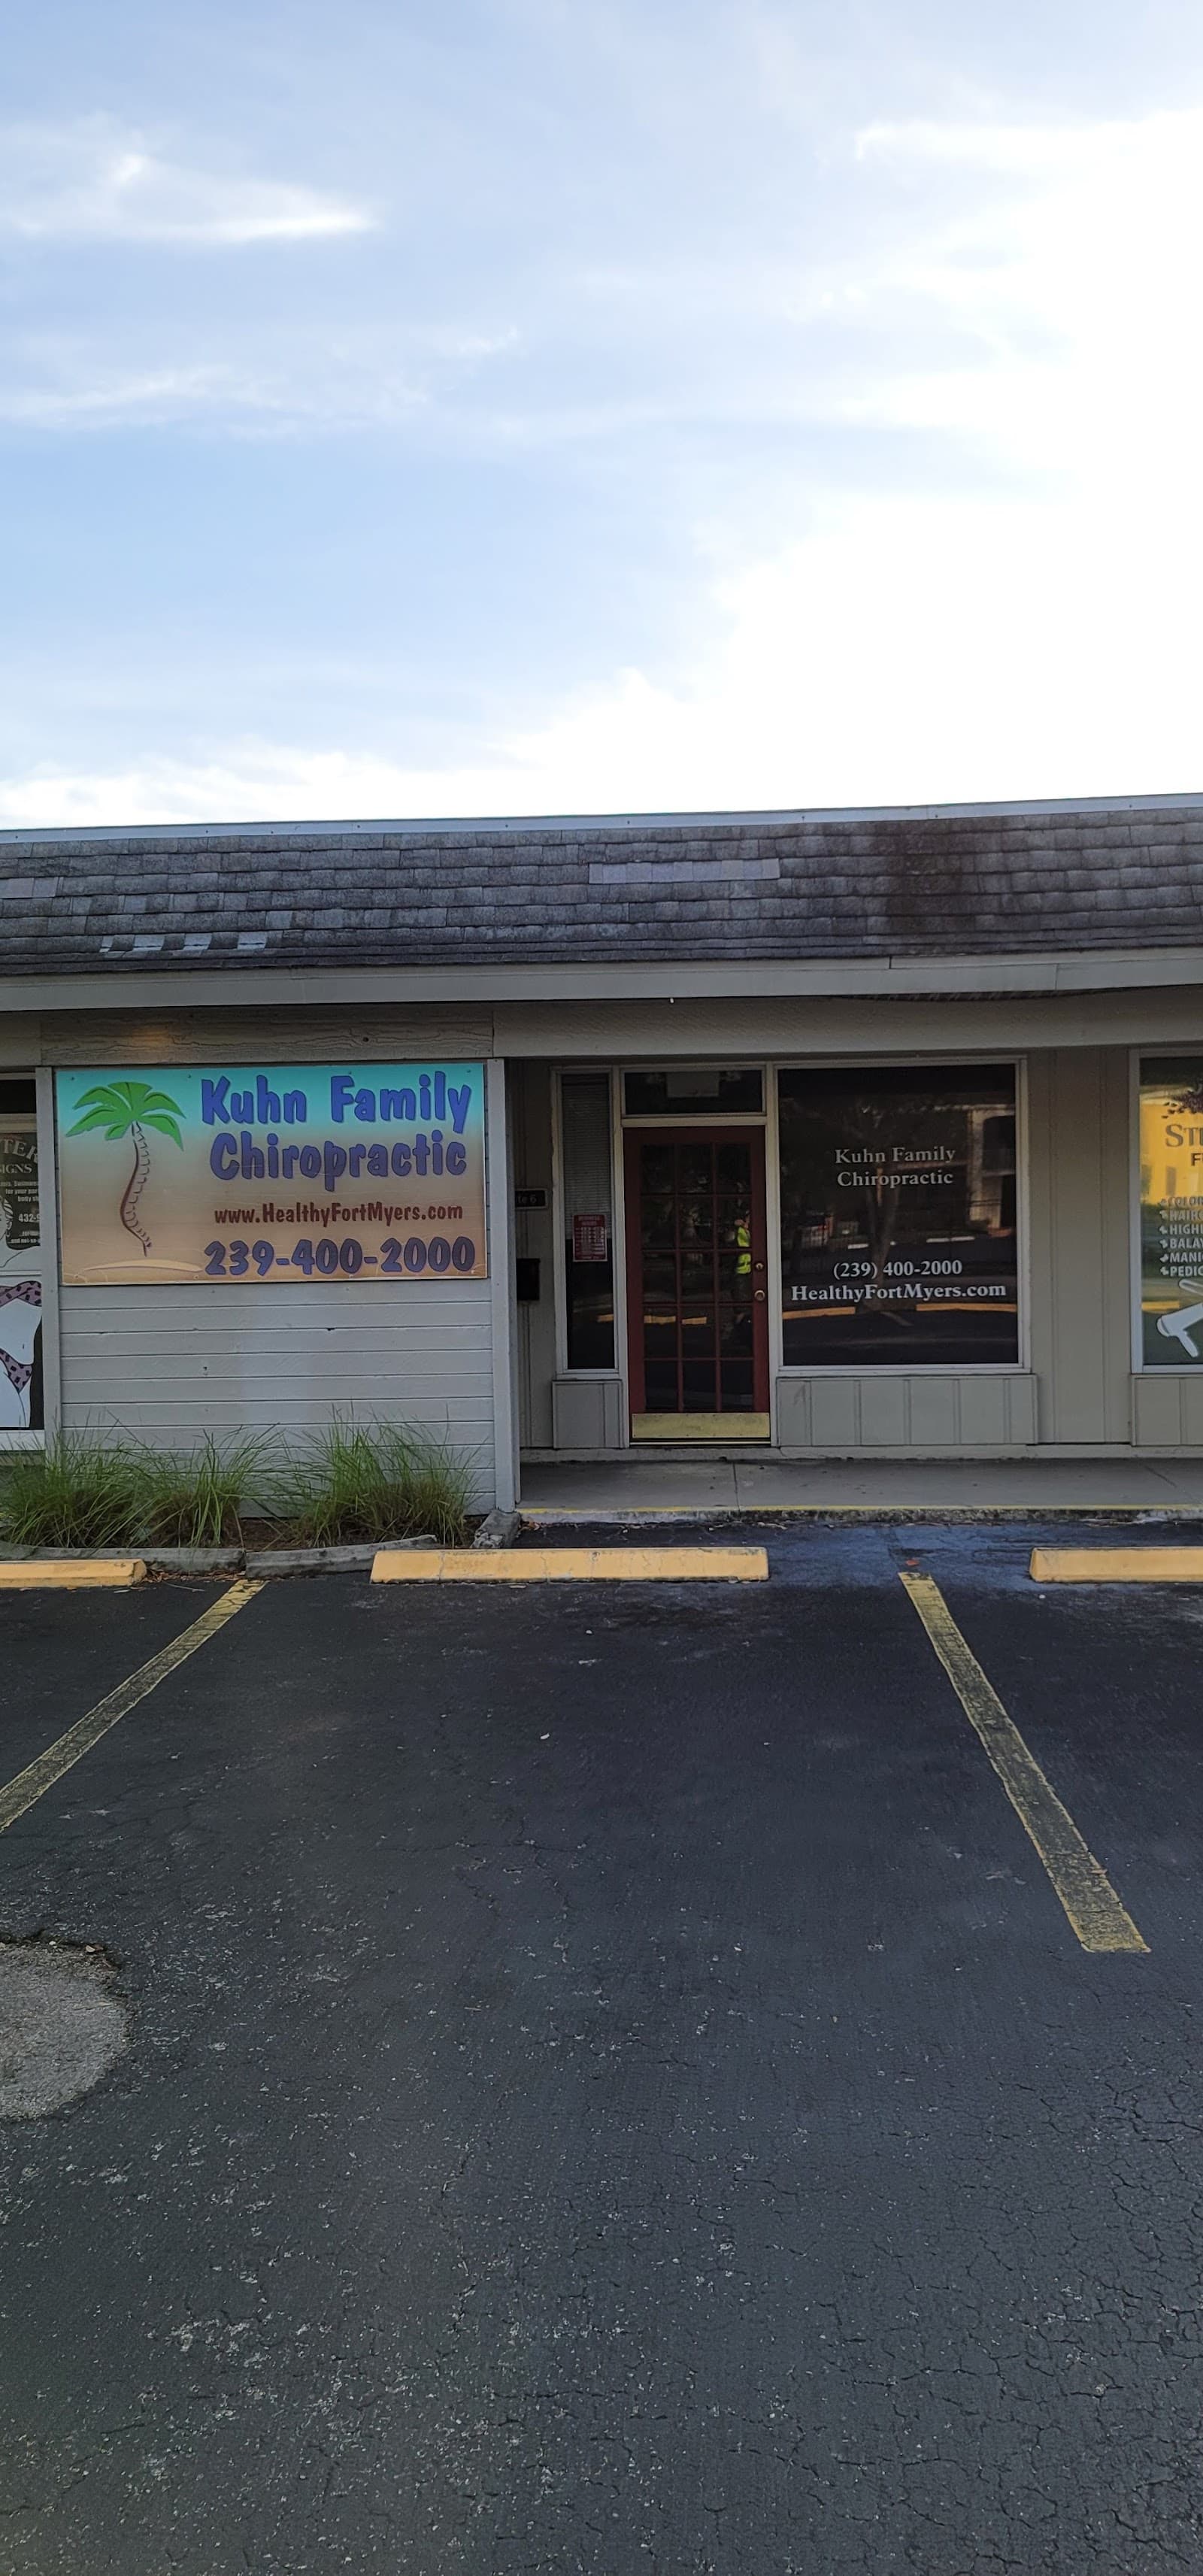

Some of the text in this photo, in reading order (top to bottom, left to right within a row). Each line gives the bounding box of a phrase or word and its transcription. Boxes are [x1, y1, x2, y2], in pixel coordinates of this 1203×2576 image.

[201, 1071, 471, 1133] Kuhn Family
[210, 1129, 467, 1192] Chiropractic
[835, 1146, 956, 1164] Kuhn Family
[0, 1164, 32, 1174] IGNS
[837, 1169, 953, 1189] Chiropractic
[214, 1202, 463, 1228] www.HealthyFortMyers.com
[204, 1235, 475, 1277] 239-400-2000
[1170, 1252, 1203, 1263] MANI
[833, 1260, 962, 1280] (239) 400-2000
[791, 1283, 1006, 1302] HealthyFortMyers.com
